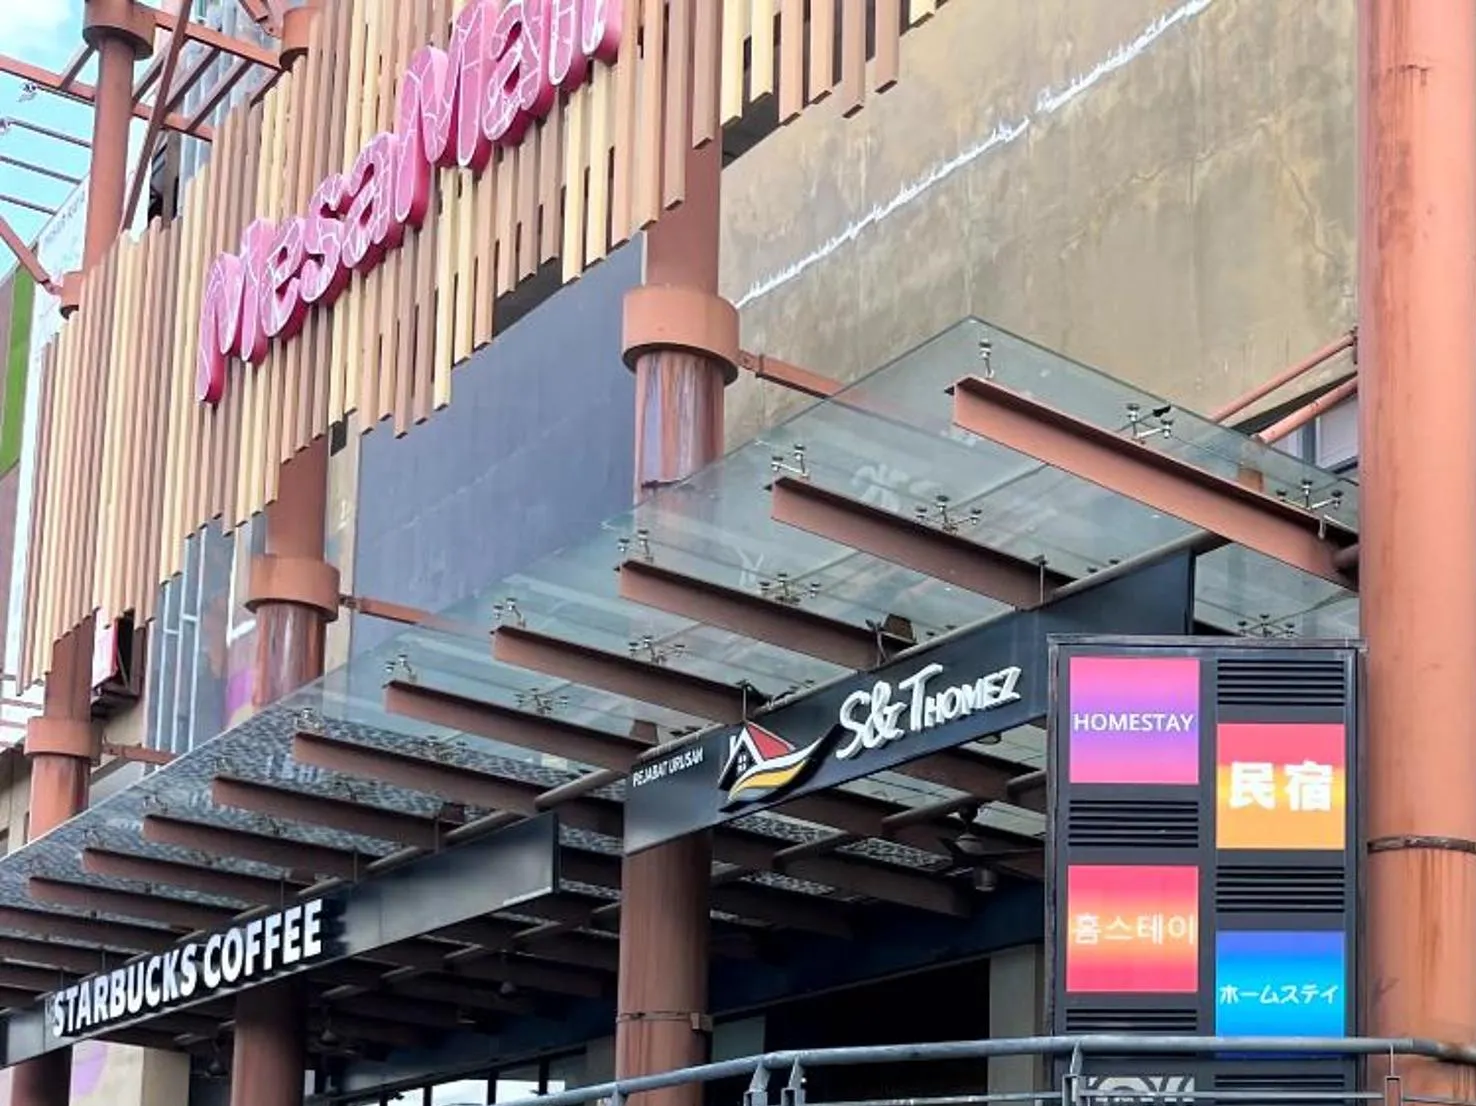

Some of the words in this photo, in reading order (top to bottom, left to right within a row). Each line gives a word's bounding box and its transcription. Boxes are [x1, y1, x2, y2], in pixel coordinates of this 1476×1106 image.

[197, 0, 622, 403] MesaMa
[1073, 713, 1194, 732] HOMESTAY
[1230, 759, 1333, 812] 民宿
[1073, 912, 1195, 945] 홈스테이
[52, 943, 197, 1037] STARBUCKS
[203, 898, 322, 988] COFFEE
